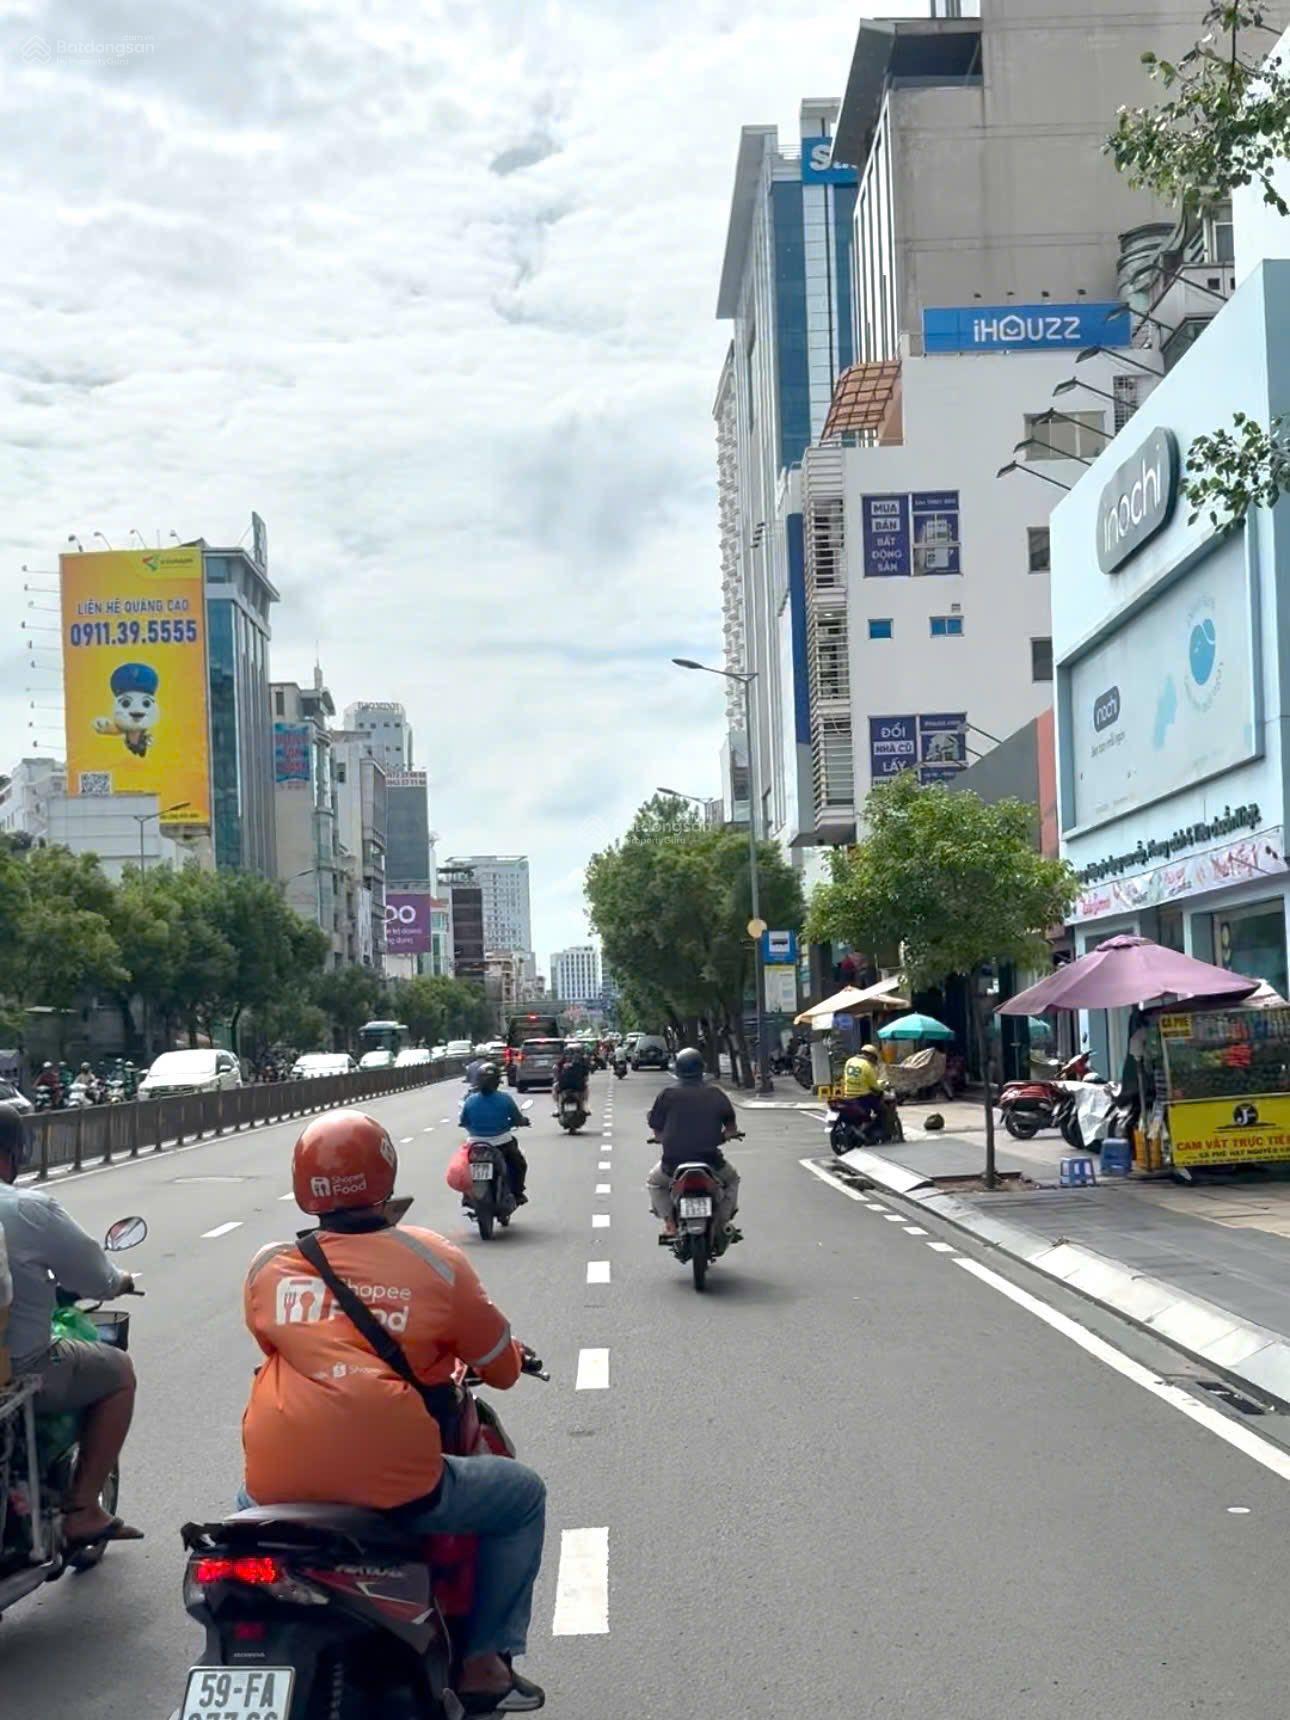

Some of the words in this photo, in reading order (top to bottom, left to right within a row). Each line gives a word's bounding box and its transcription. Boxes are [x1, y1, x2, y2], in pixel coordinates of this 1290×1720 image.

[873, 503, 898, 513] MUA
[1104, 443, 1161, 553] inochi
[78, 598, 102, 615] LIÊN
[70, 620, 197, 647] 0911.39.5555
[1176, 1141, 1202, 1152] CAM
[333, 1180, 367, 1195] Food
[341, 1278, 412, 1303] hopee
[199, 1672, 275, 1707] 59-FA
